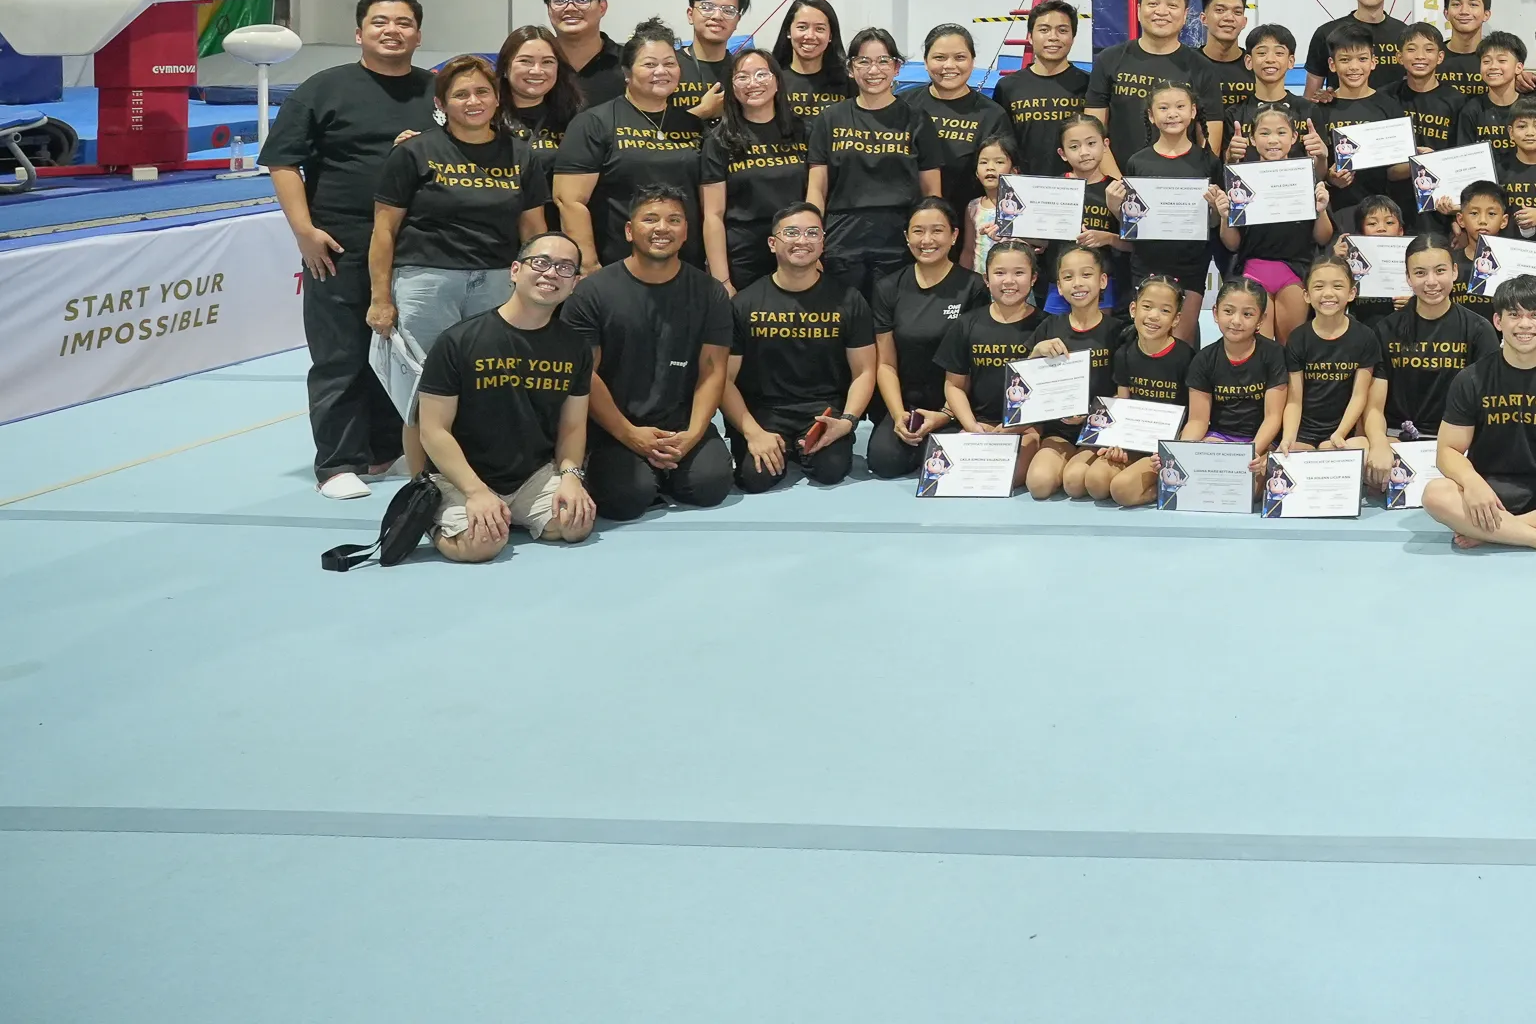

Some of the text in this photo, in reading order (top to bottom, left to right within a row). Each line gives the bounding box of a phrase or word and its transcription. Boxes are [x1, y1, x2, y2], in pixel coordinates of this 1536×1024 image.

[1379, 44, 1400, 52] YOU
[152, 65, 196, 74] GYMNOVA
[1118, 73, 1154, 84] START
[1228, 83, 1253, 91] YOU
[1012, 98, 1047, 110] START
[942, 119, 978, 129] YOUR
[1419, 113, 1450, 126] YOUR
[833, 128, 870, 140] START
[1478, 126, 1504, 135] TART
[832, 140, 909, 156] IMPOSSIBLE
[427, 160, 476, 174] START
[728, 155, 806, 172] IMPOSSIBL
[435, 177, 519, 190] MPOSSIBL
[1500, 183, 1530, 192] TART
[1085, 206, 1110, 215] YOU
[64, 272, 225, 321] START YOUR
[751, 312, 840, 322] START YOUR
[59, 304, 220, 357] IMPOSSIBLE
[752, 327, 839, 338] IMPOSSIBLE
[972, 344, 1026, 353] START YO
[1092, 349, 1109, 357] OUR
[1433, 342, 1467, 353] YOUR
[475, 358, 573, 373] START YOUR
[477, 375, 569, 391] IMPOSIBLE
[1151, 378, 1176, 388] YOUR
[1244, 381, 1266, 392] YOU
[1127, 386, 1175, 399] MPOSSIBLE
[1482, 394, 1523, 408] START
